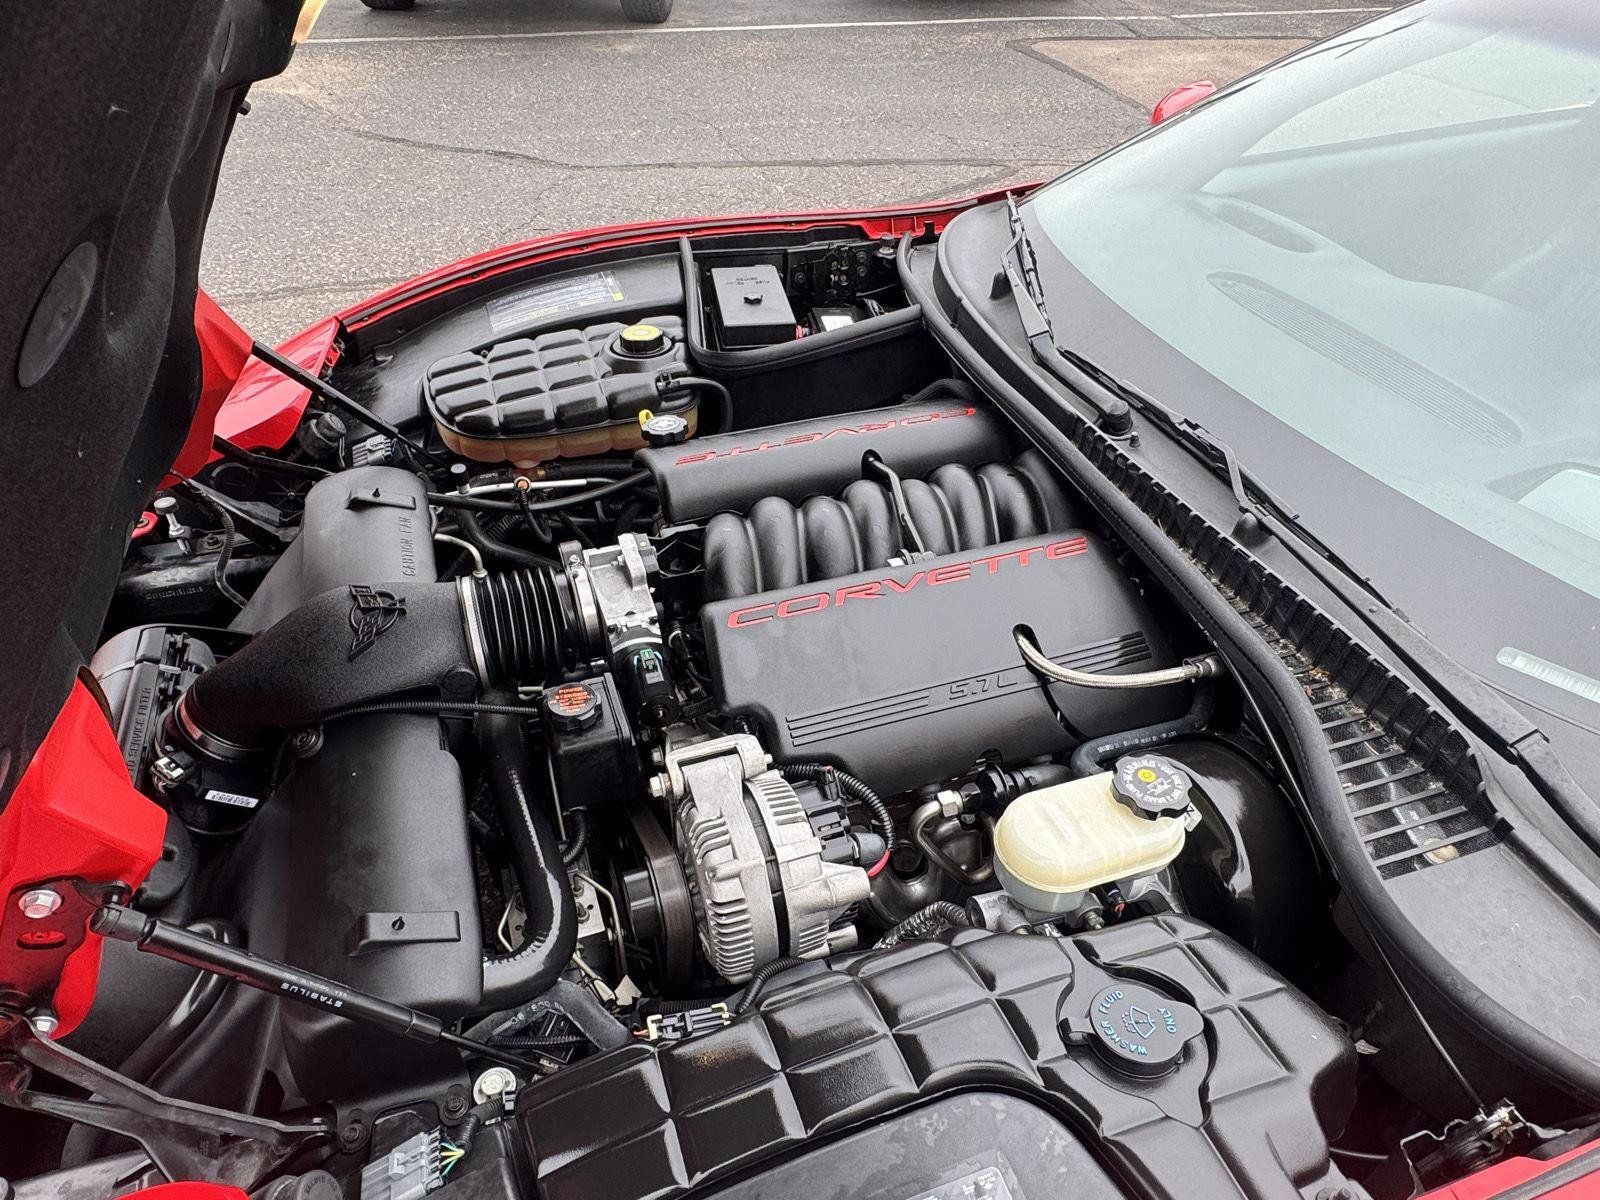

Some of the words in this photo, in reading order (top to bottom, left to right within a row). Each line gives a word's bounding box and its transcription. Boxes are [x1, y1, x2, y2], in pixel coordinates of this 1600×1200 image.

[674, 406, 976, 465] CORVETTE
[400, 538, 416, 577] CAUTION
[727, 536, 1088, 629] CORVETTE
[949, 673, 1018, 700] 5.7L
[128, 719, 145, 757] SERVICE
[1123, 759, 1156, 781] WARNING
[280, 982, 343, 1008] STABILUS
[1099, 990, 1123, 1015] FLUID
[1157, 1007, 1177, 1034] ONLY
[1101, 1020, 1147, 1056] WASHER
